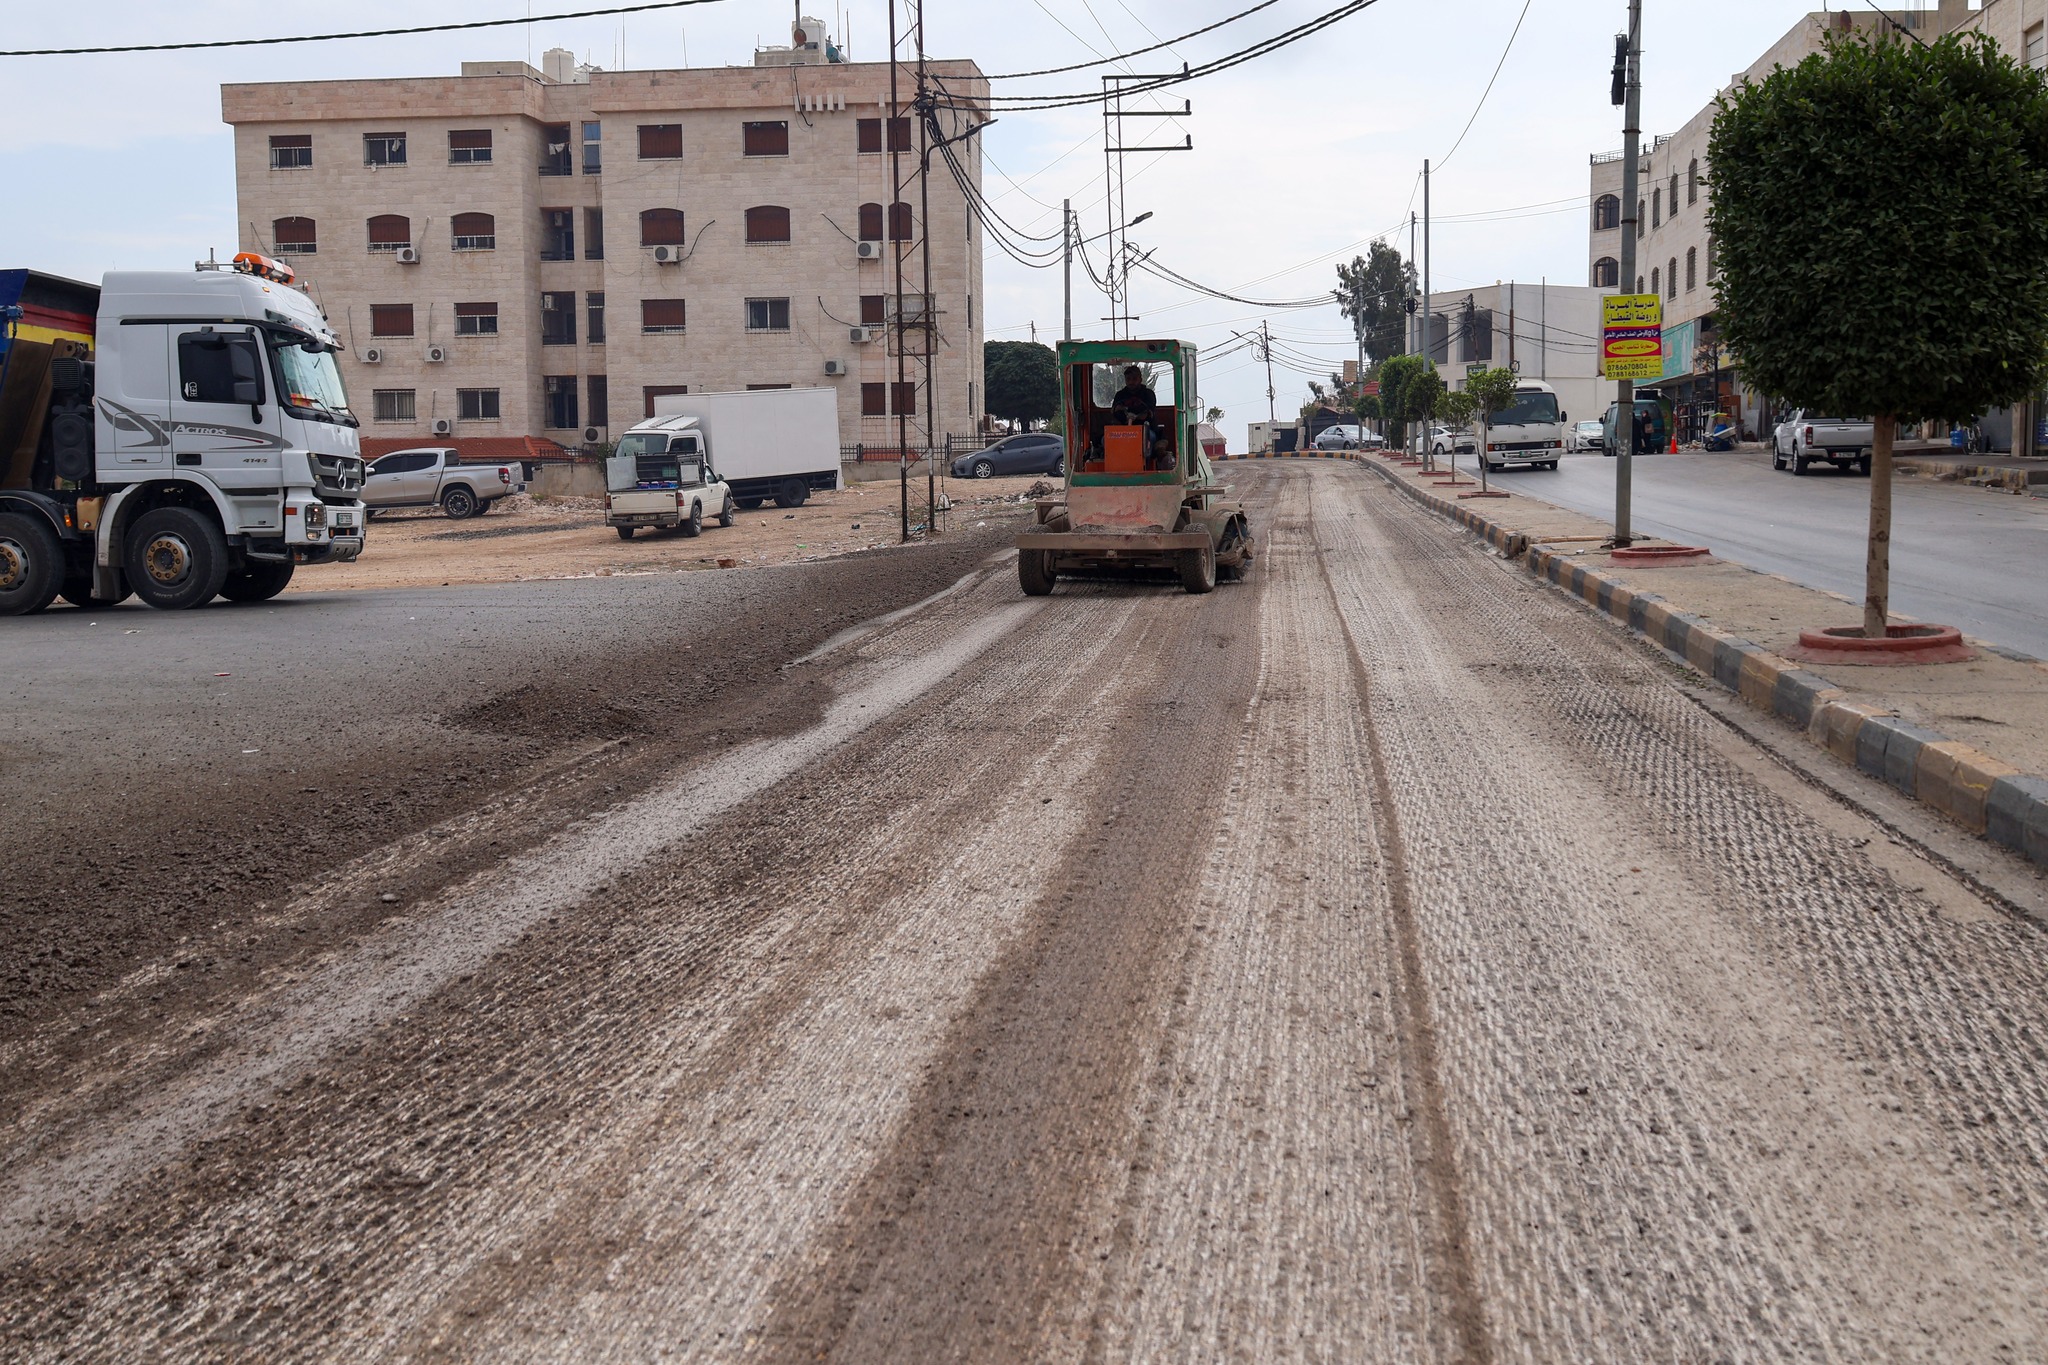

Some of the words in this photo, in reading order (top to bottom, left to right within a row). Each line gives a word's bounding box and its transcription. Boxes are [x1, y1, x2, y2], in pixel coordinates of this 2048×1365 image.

[1634, 298, 1655, 310] مدرسة
[1606, 311, 1634, 324] القبطان
[1635, 310, 1652, 322] روضة
[1607, 363, 1648, 371] 0786670804
